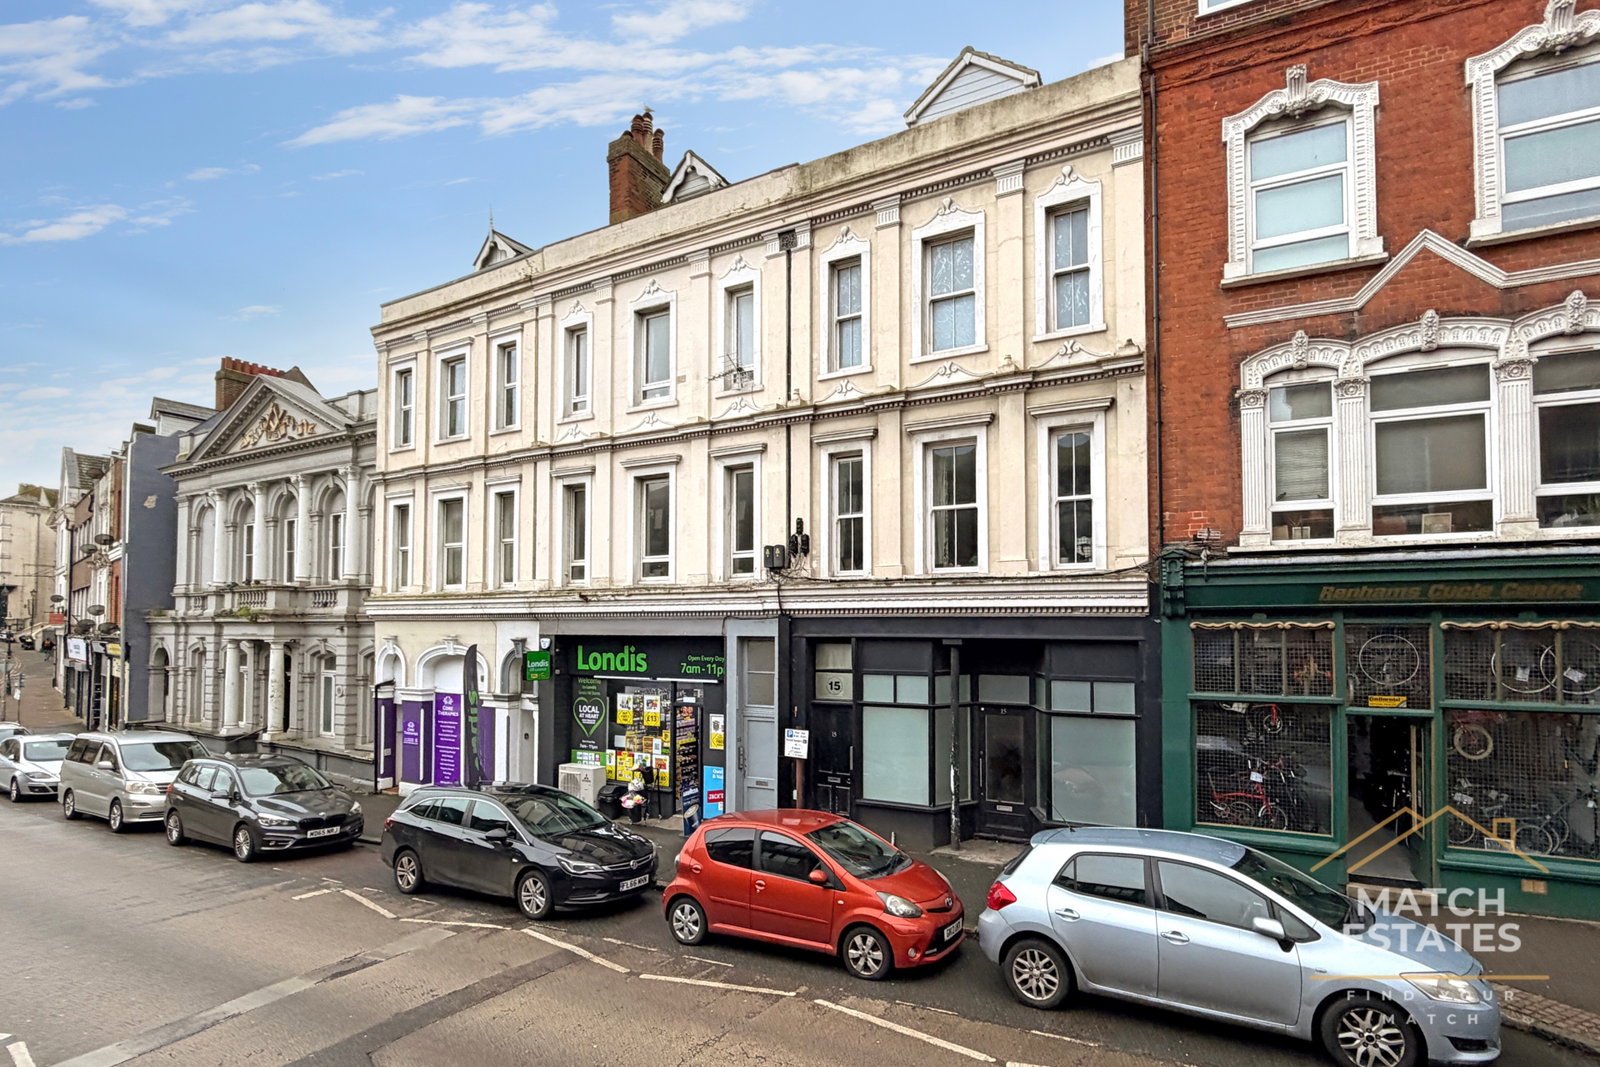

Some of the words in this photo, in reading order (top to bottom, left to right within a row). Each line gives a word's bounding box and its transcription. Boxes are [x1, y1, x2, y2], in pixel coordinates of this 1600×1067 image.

[527, 659, 549, 668] Londis
[577, 645, 648, 673] Londis
[687, 655, 701, 663] Open
[702, 655, 714, 663] Every
[715, 656, 725, 664] Day
[680, 663, 701, 674] 7am
[706, 664, 724, 677] 11p
[828, 681, 841, 691] 15
[578, 705, 600, 714] LOCAL
